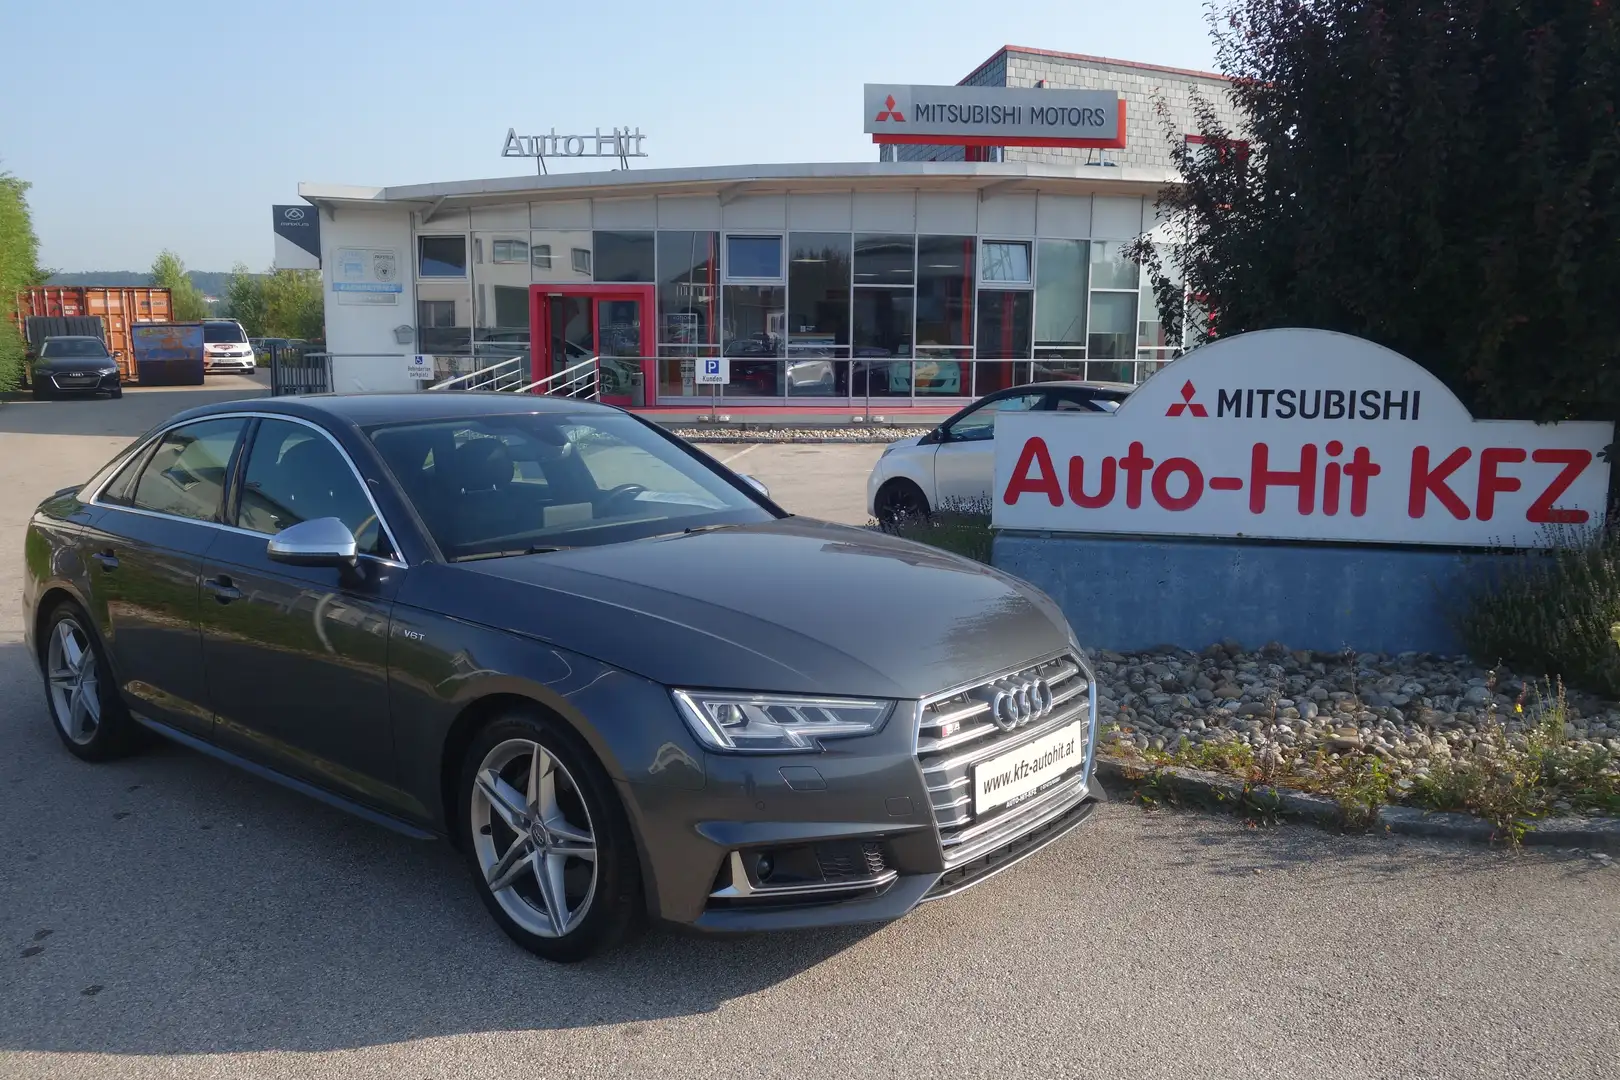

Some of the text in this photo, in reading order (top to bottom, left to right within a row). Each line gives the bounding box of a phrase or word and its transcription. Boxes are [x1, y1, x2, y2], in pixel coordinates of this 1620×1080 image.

[915, 103, 1105, 127] MITSUBISHI MOTORS
[501, 126, 648, 157] Auto Hit
[1217, 388, 1421, 421] MITSUBISHI
[1003, 436, 1592, 523] Auto-Hit KFZ
[404, 629, 425, 641] V6T
[983, 739, 1075, 795] www.kfz-autohit.at
